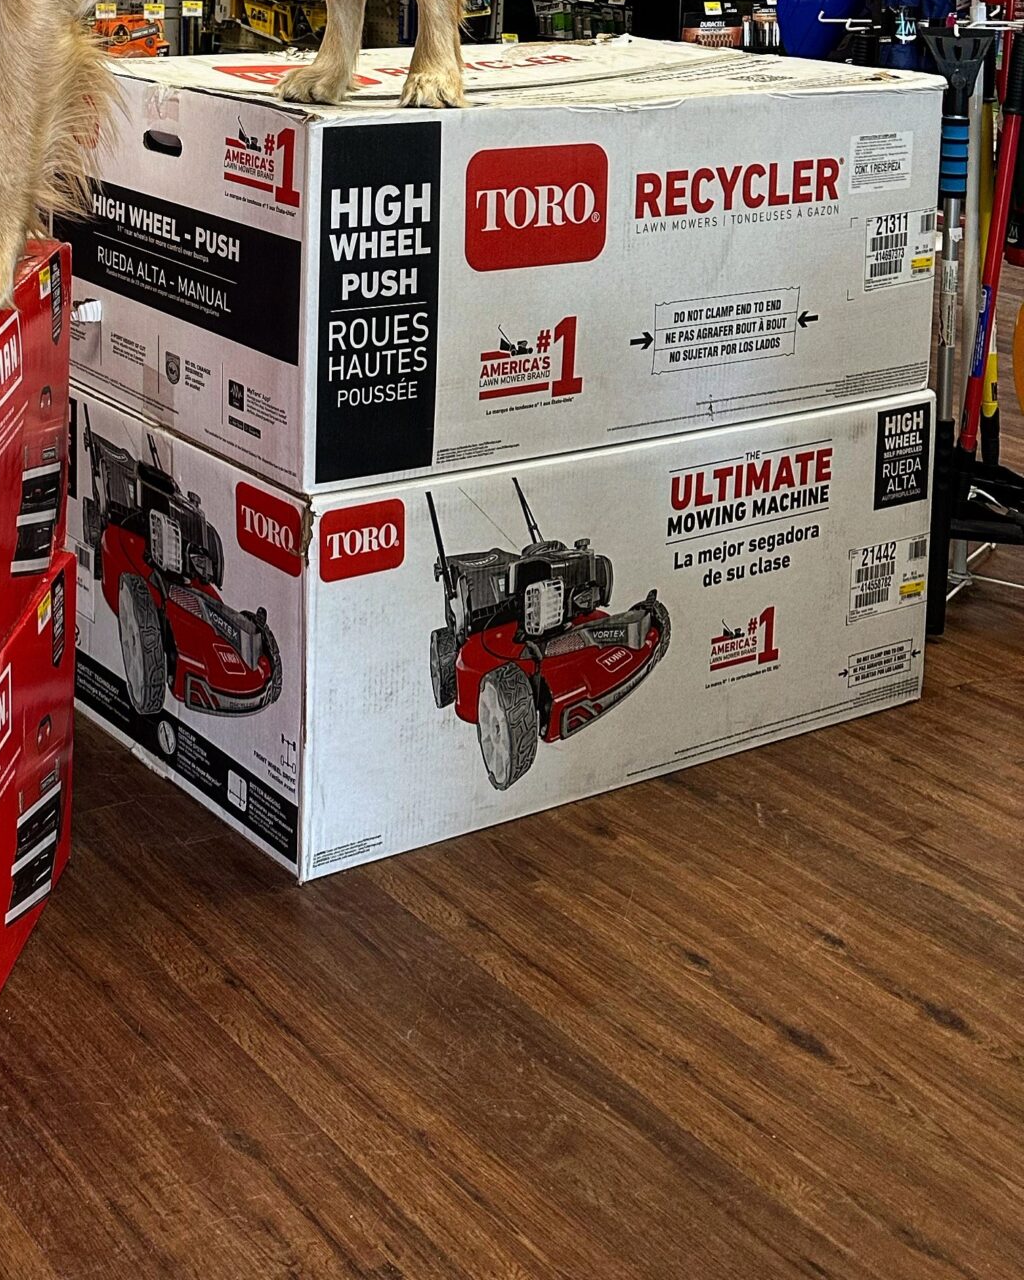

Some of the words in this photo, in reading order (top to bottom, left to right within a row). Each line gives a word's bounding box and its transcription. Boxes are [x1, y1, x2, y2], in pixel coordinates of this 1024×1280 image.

[223, 160, 238, 170] LAWN
[238, 164, 257, 176] MOWER
[257, 168, 275, 181] BRAND
[224, 148, 275, 173] AMERICA'S
[634, 157, 840, 220] RECYCLER
[331, 182, 432, 230] HIGH
[476, 182, 596, 232] TORO
[635, 221, 667, 234] LAWN
[672, 216, 718, 231] MOWERS
[731, 209, 792, 225] TONDEUSES
[796, 206, 803, 218] À
[807, 204, 840, 218] GAZON
[92, 193, 126, 224] HIGH
[129, 204, 181, 242] WHEEL
[195, 226, 240, 262] PUSH
[876, 212, 909, 236] 21311
[329, 228, 432, 262] WHEEL
[97, 245, 135, 276] RUEDA
[137, 261, 167, 288] ALTA
[178, 275, 232, 313] MANUAL
[341, 268, 418, 301] PUSH
[673, 311, 685, 323] DO
[687, 309, 704, 322] NOT
[705, 305, 734, 319] CLAMP
[736, 303, 752, 315] END
[754, 301, 764, 313] TO
[766, 299, 782, 311] END
[328, 312, 429, 352] ROUES
[665, 332, 676, 344] NE
[678, 330, 695, 342] PAS
[696, 325, 734, 340] AGRAFER
[736, 321, 757, 334] BOUT
[758, 317, 764, 331] À
[766, 317, 787, 330] BOUT
[669, 350, 680, 363] NO
[682, 345, 719, 361] SUJETAR
[720, 343, 737, 356] POR
[738, 340, 754, 353] LOS
[755, 337, 781, 351] LADOS
[328, 346, 428, 382] HAUTES
[479, 356, 551, 379] AMERICA'S
[479, 377, 499, 388] LAWN
[500, 374, 525, 384] MOWER
[527, 370, 550, 381] BRAND
[337, 378, 418, 408] POUSSÉE
[884, 409, 924, 436] HIGH
[884, 431, 923, 450] WHEEL
[896, 445, 923, 457] PROPELLED
[745, 450, 761, 461] THE
[882, 457, 922, 479] RUEDA
[670, 447, 833, 511] ULTIMATE
[887, 473, 917, 494] ALTA
[881, 488, 921, 502] AUTOPROPULSADO
[667, 501, 746, 537] MOWING
[752, 484, 830, 519] MACHINE
[241, 504, 295, 553] TORO
[326, 523, 398, 561] TORO
[674, 550, 693, 570] La
[697, 540, 745, 566] mejor
[748, 524, 820, 553] segadora
[862, 541, 896, 567] 21442
[703, 568, 722, 587] de
[726, 564, 745, 582] su
[752, 553, 791, 576] clase
[207, 607, 238, 639] VORTEX
[593, 629, 626, 639] VORTEX
[219, 650, 241, 665] TORO
[602, 649, 626, 666] TORO
[710, 636, 757, 657] AMERICA'S
[723, 651, 740, 661] MOWER
[740, 646, 757, 656] BRAND
